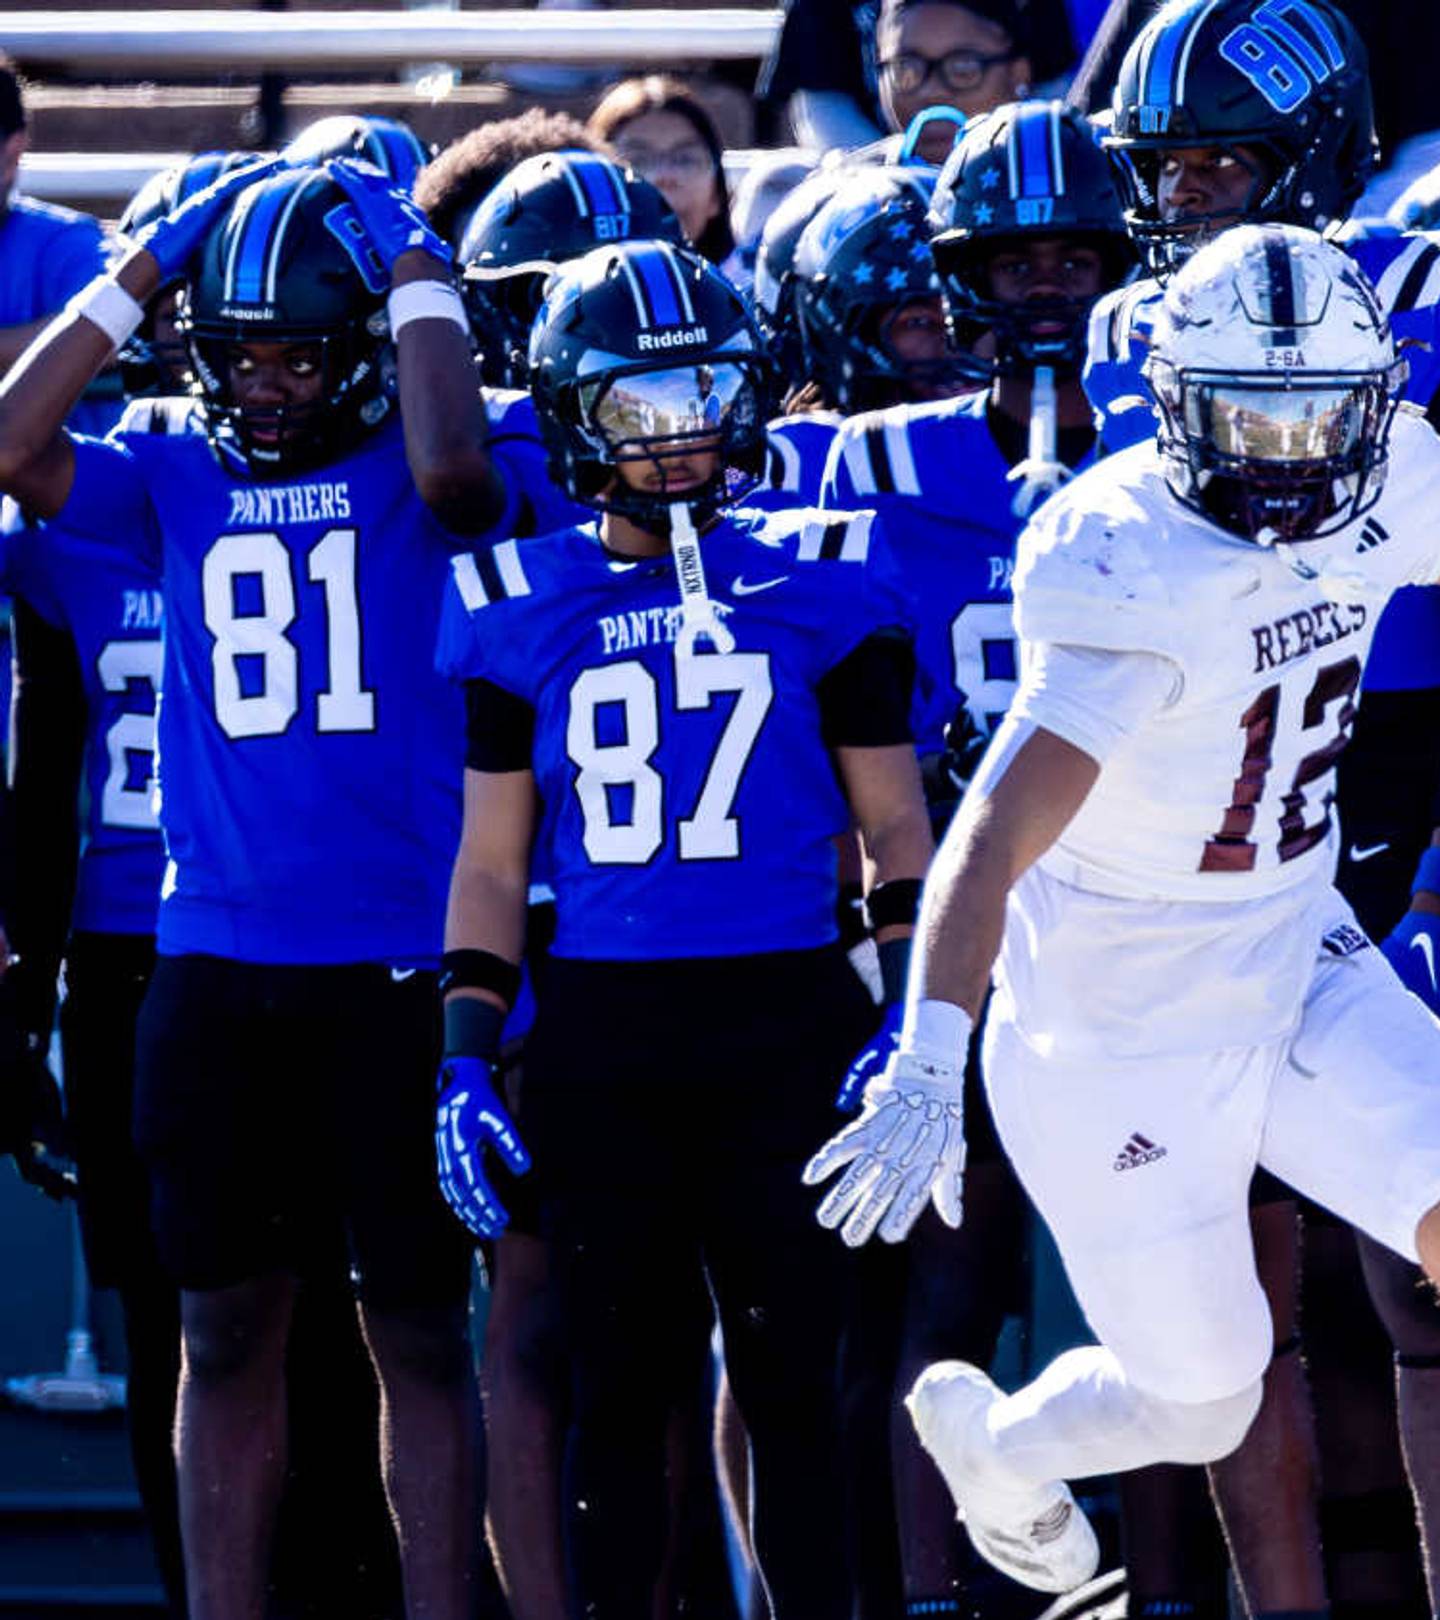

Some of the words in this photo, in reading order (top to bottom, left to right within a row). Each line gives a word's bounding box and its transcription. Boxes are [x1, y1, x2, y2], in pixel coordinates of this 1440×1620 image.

[1218, 0, 1346, 114] 817
[593, 215, 630, 239] 817
[637, 327, 708, 350] Riddell
[227, 482, 351, 526] PANTHERS
[202, 531, 376, 739] 81
[1250, 600, 1367, 674] REBELS
[97, 638, 165, 828] 2
[566, 653, 774, 864] 87
[1197, 654, 1361, 873] 12
[1113, 1147, 1168, 1172] adidas
